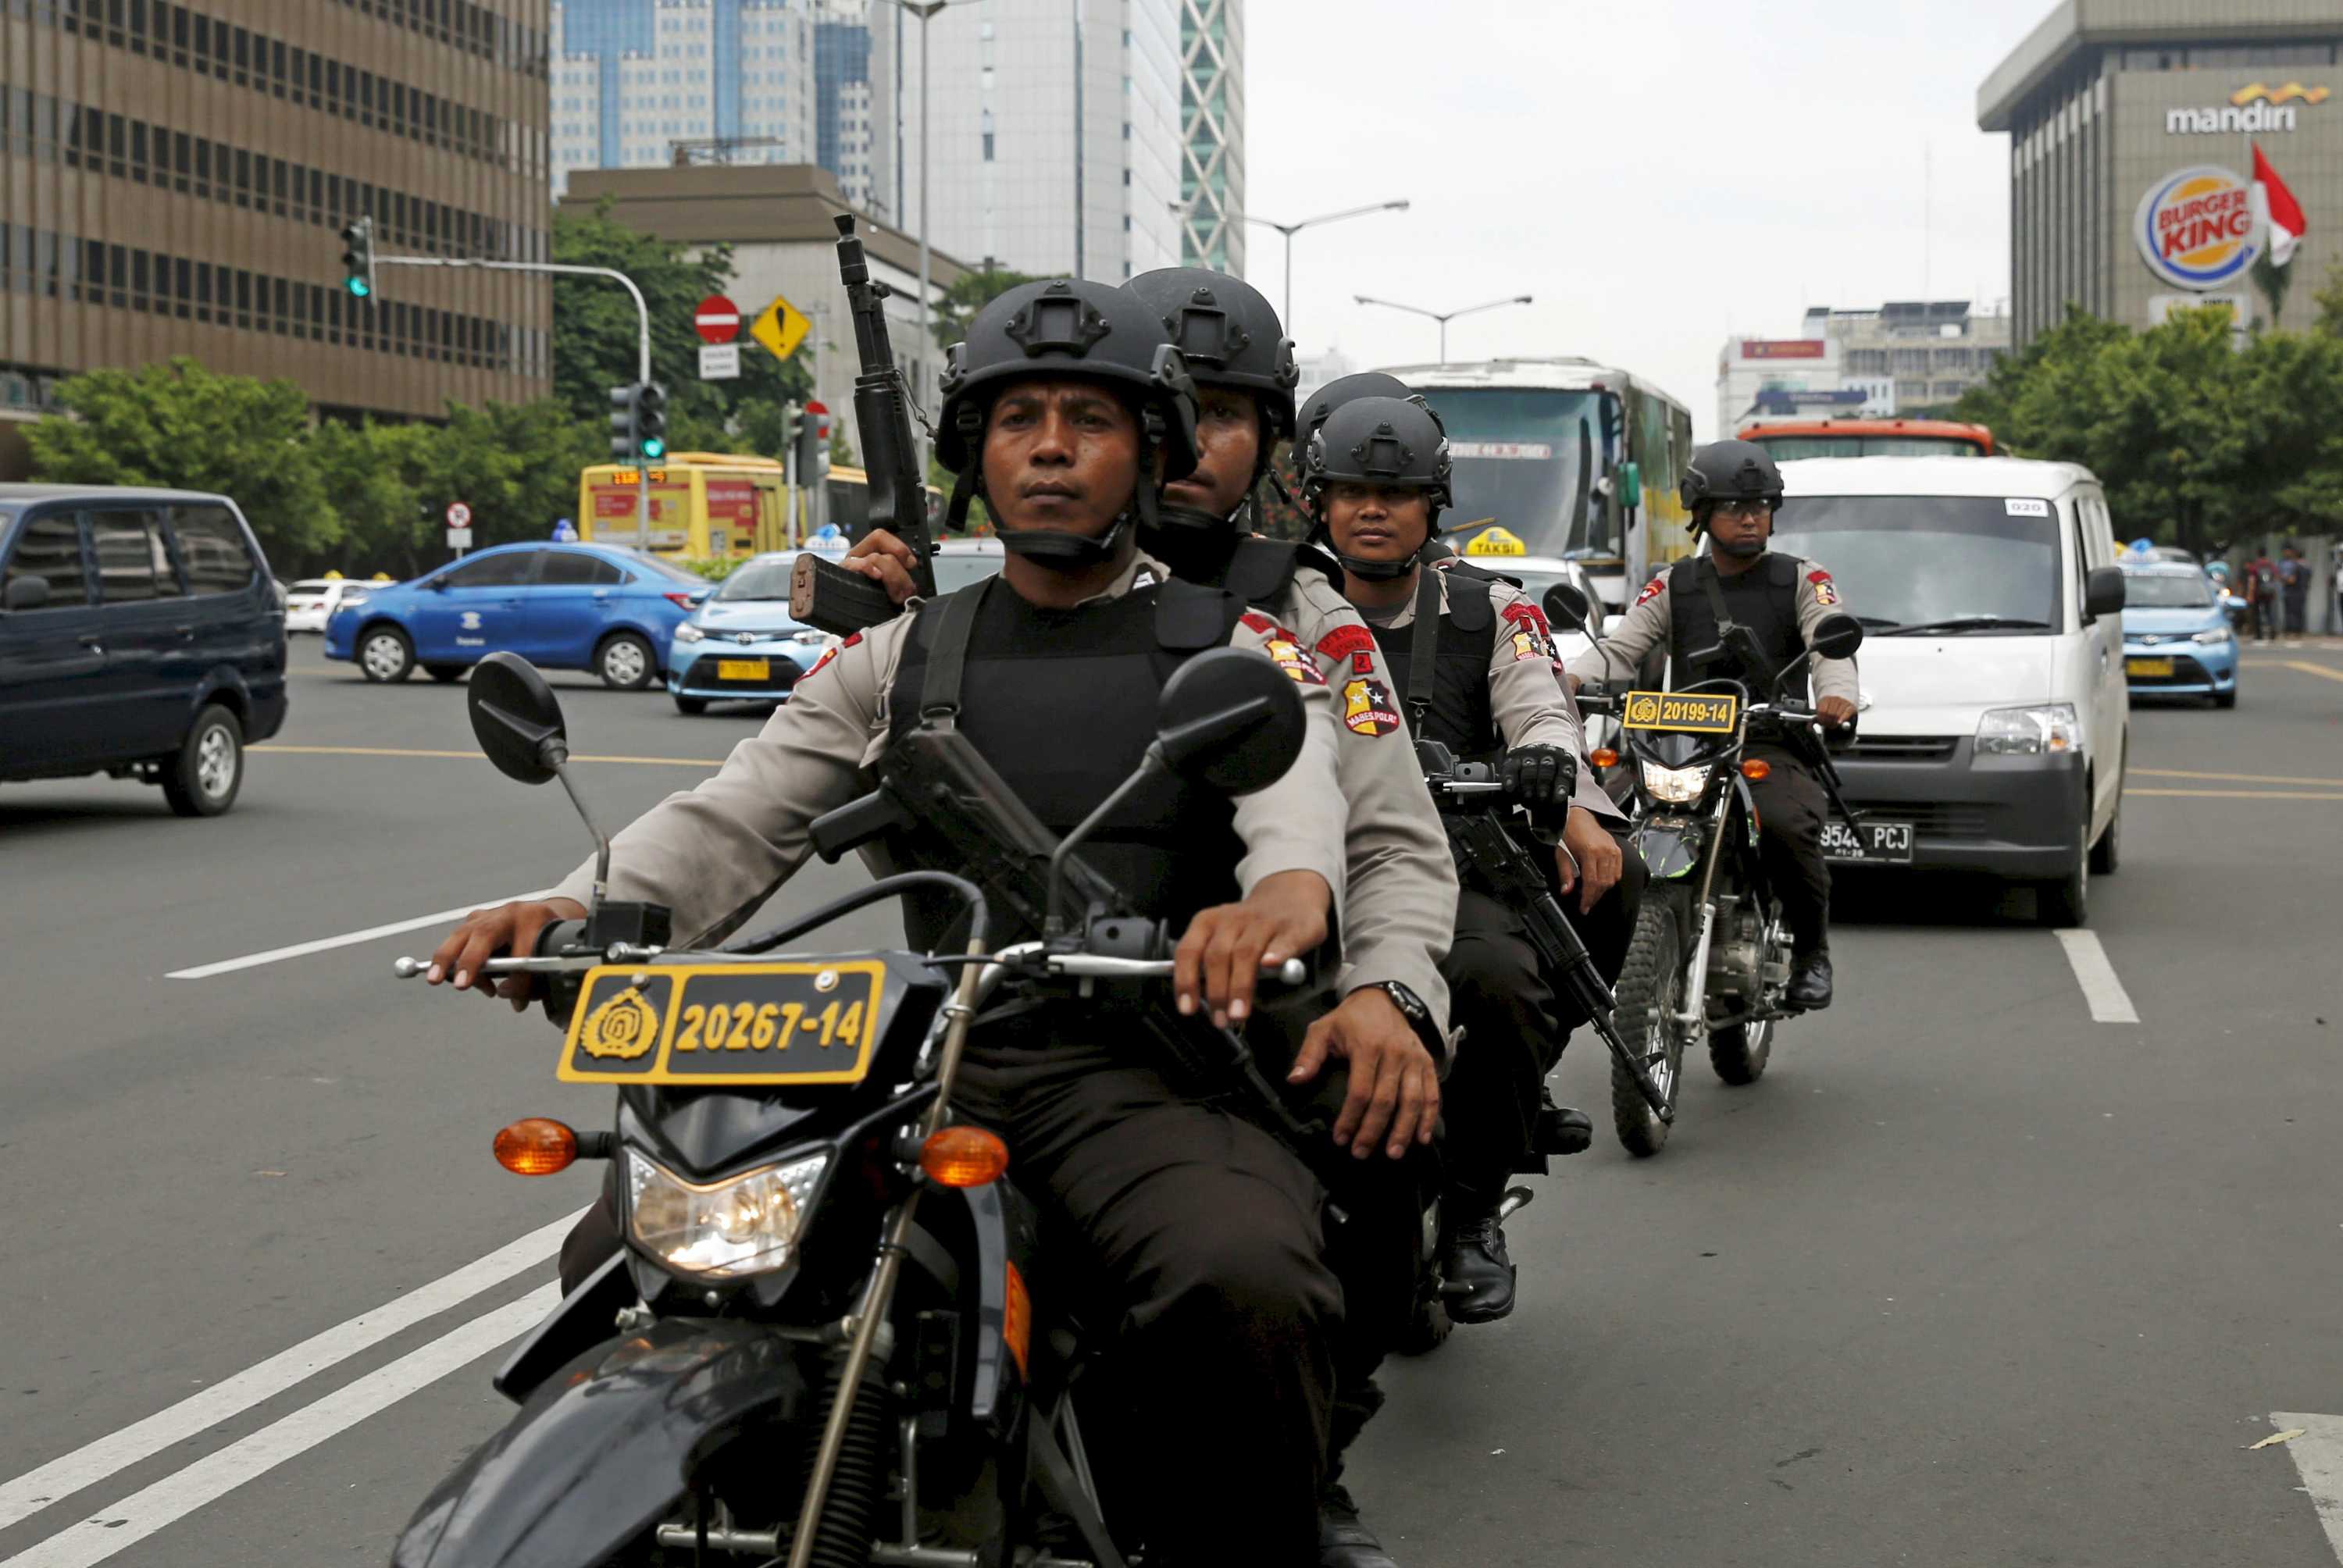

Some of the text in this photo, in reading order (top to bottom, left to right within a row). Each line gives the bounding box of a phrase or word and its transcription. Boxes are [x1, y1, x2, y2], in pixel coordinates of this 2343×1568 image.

[2166, 98, 2296, 133] mandiri
[2158, 190, 2247, 231] BURGER
[2163, 210, 2252, 259] KING
[1476, 543, 1515, 554] TAKSI
[1662, 701, 1728, 722] 20199-14
[1874, 827, 1909, 850] PCJ
[676, 1000, 863, 1050] 20267-14
